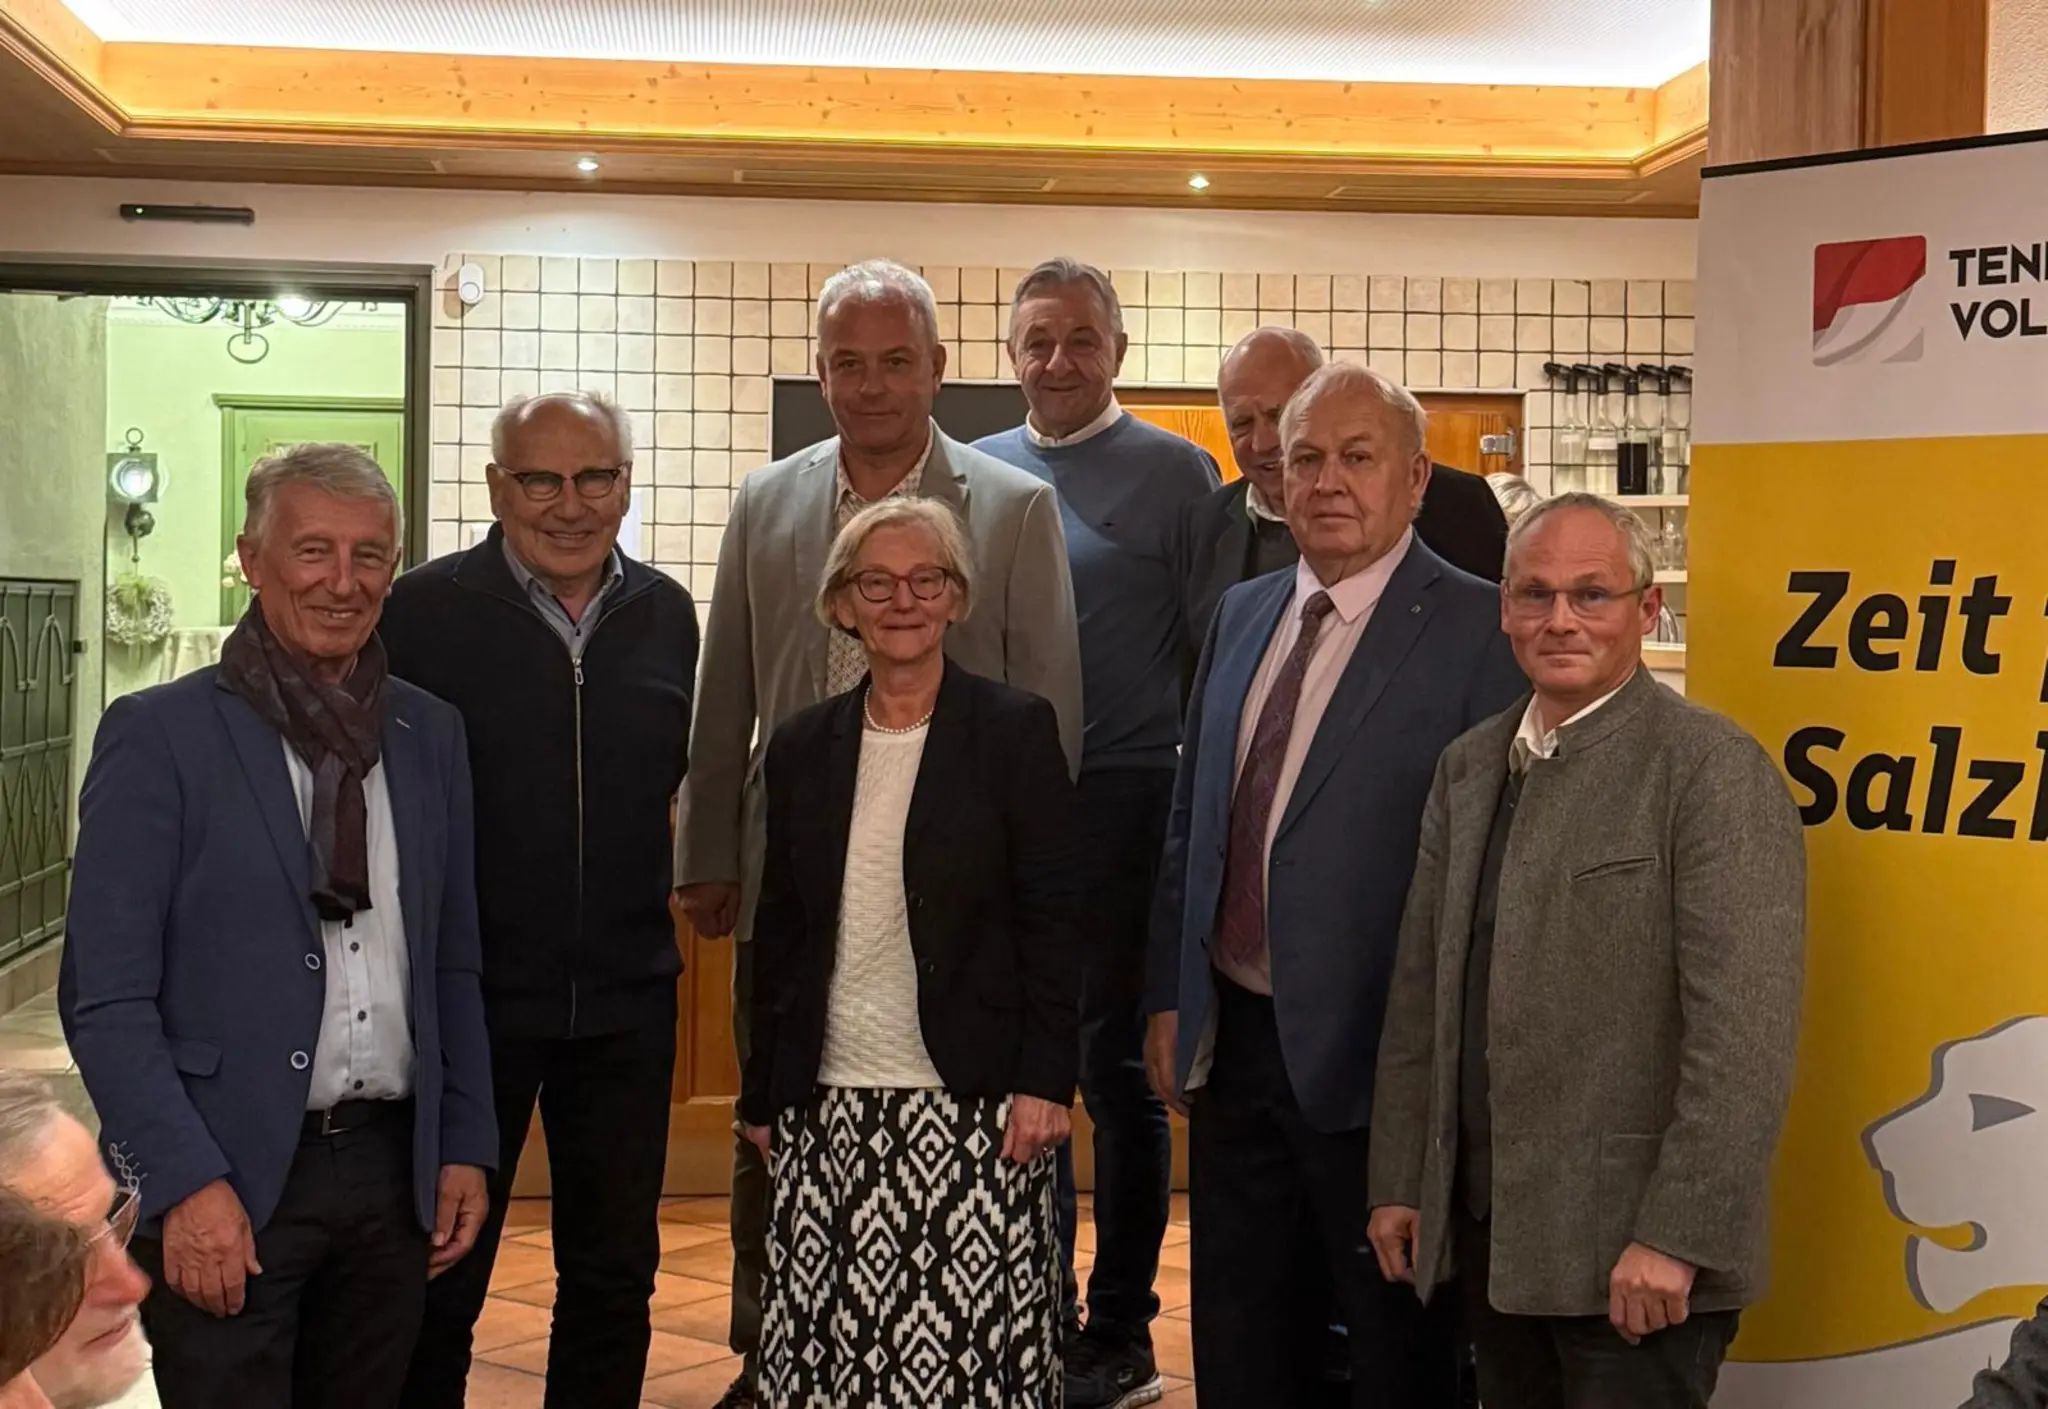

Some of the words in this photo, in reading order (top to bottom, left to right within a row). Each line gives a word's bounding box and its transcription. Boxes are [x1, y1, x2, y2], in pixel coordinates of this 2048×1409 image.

[1949, 241, 2048, 287] TEN
[1950, 298, 2048, 341] VOL
[1773, 559, 2012, 675] Zeit
